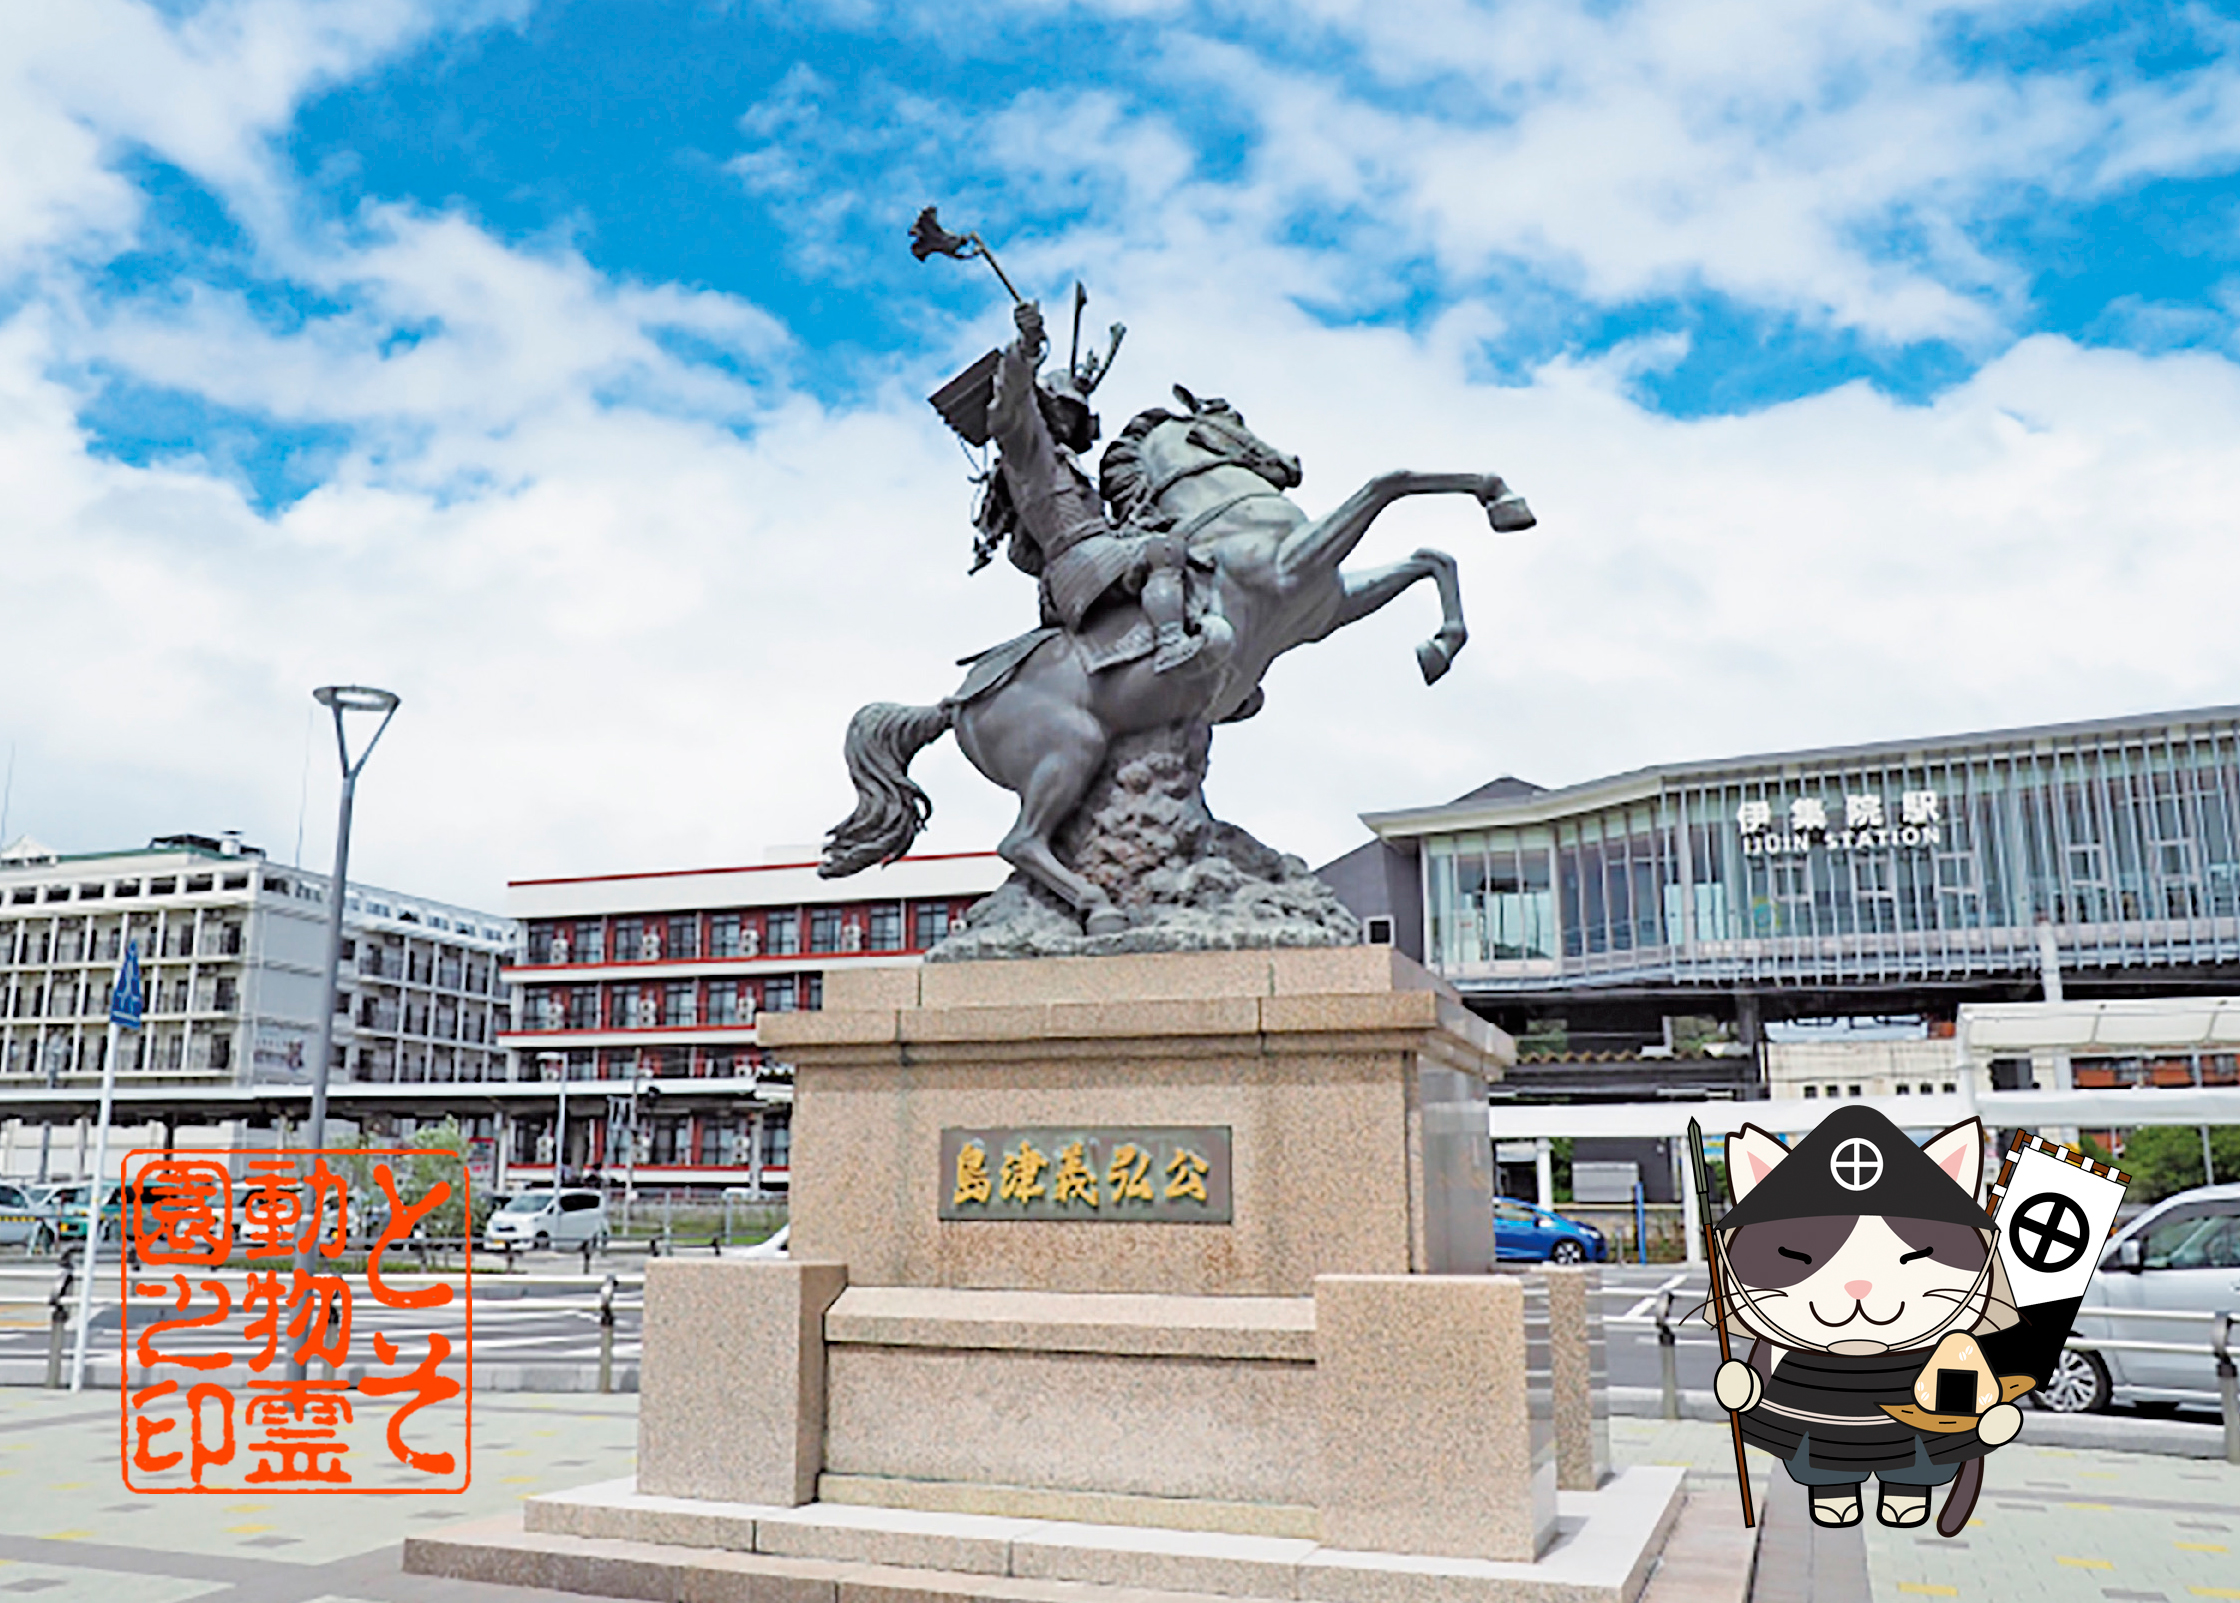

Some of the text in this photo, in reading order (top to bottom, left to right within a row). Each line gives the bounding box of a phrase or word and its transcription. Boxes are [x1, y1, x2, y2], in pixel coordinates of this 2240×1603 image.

[1737, 790, 1940, 833] 伊集院駅
[1824, 826, 1940, 850] STATION
[953, 1141, 1209, 1207] 島津義弘公
